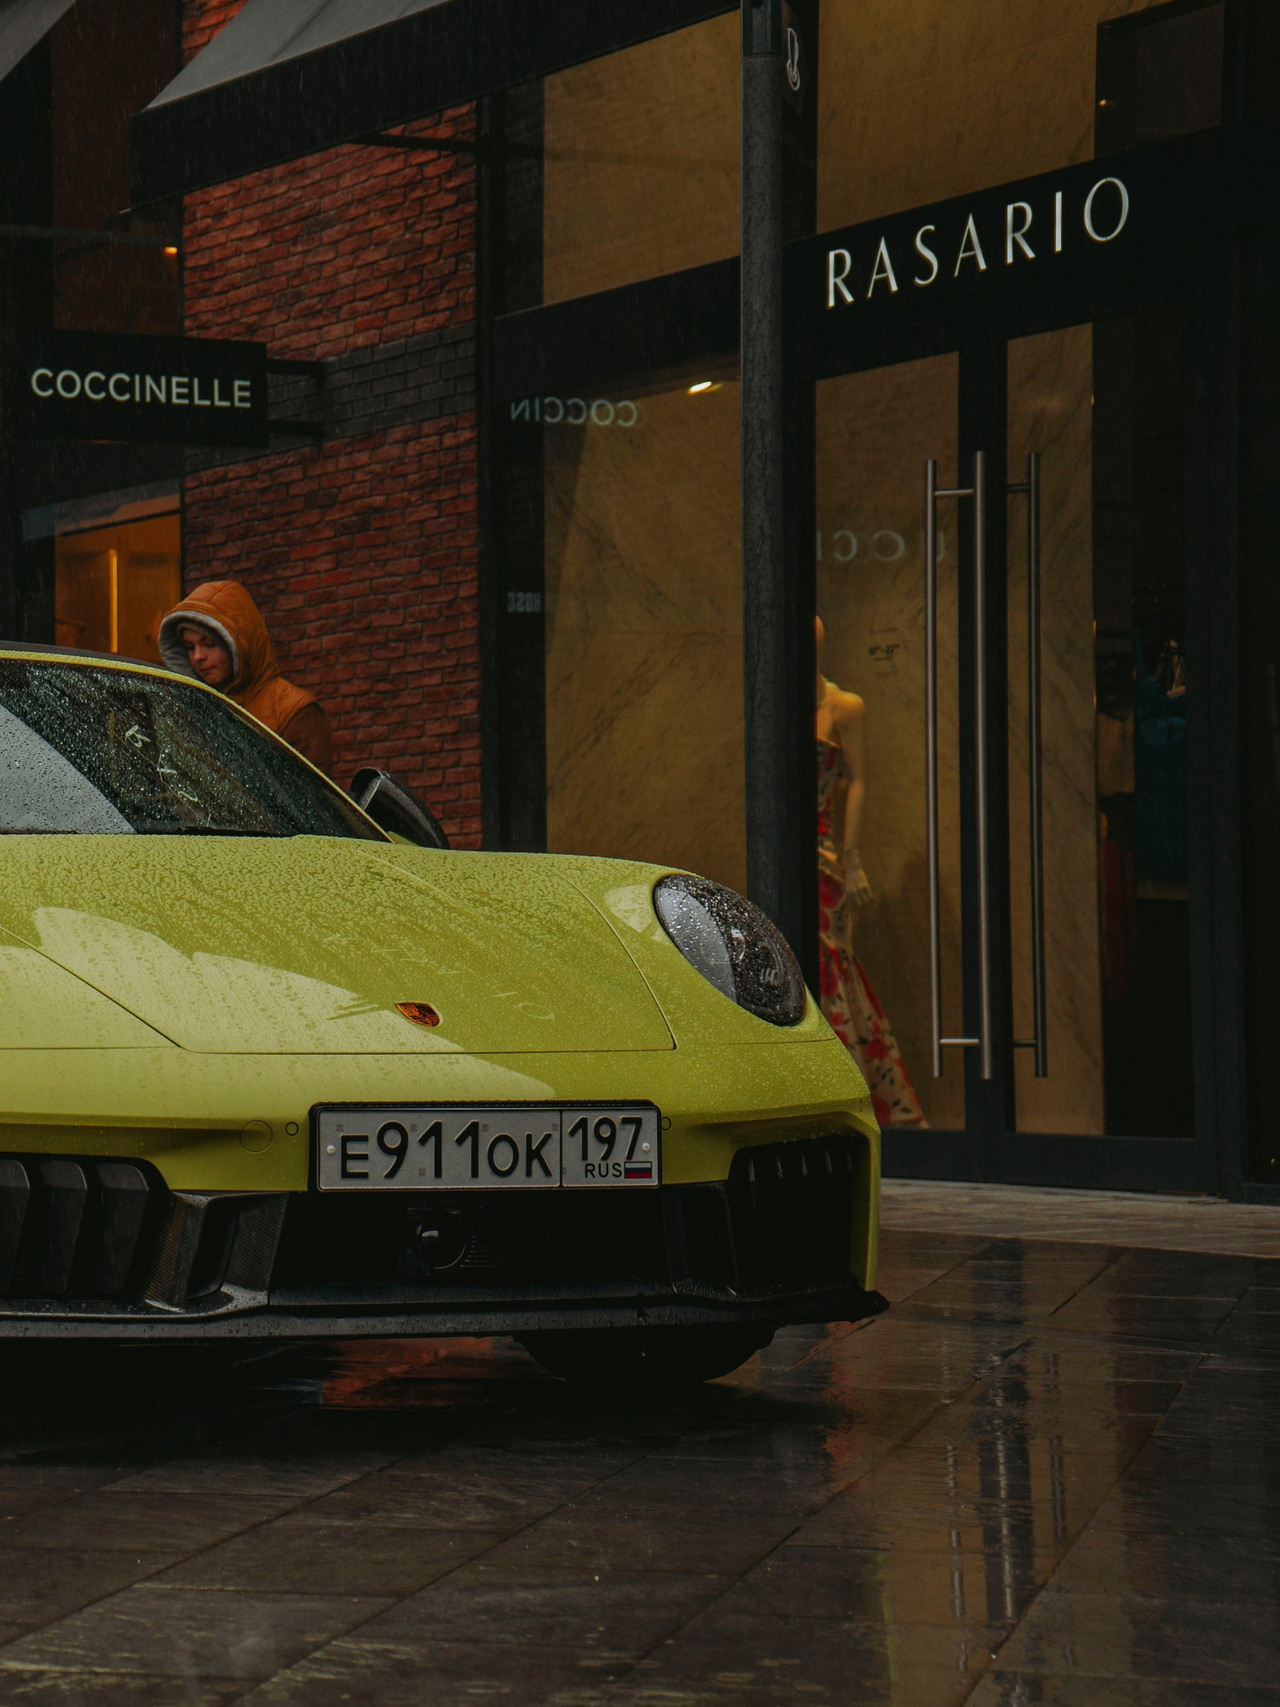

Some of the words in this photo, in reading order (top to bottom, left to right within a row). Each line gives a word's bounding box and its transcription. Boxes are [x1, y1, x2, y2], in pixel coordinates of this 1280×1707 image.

[826, 176, 1130, 309] RASARIO
[31, 367, 252, 409] COCCINELLE
[340, 1120, 553, 1179] E911OK
[568, 1116, 643, 1162] 197
[584, 1163, 623, 1178] RUS
